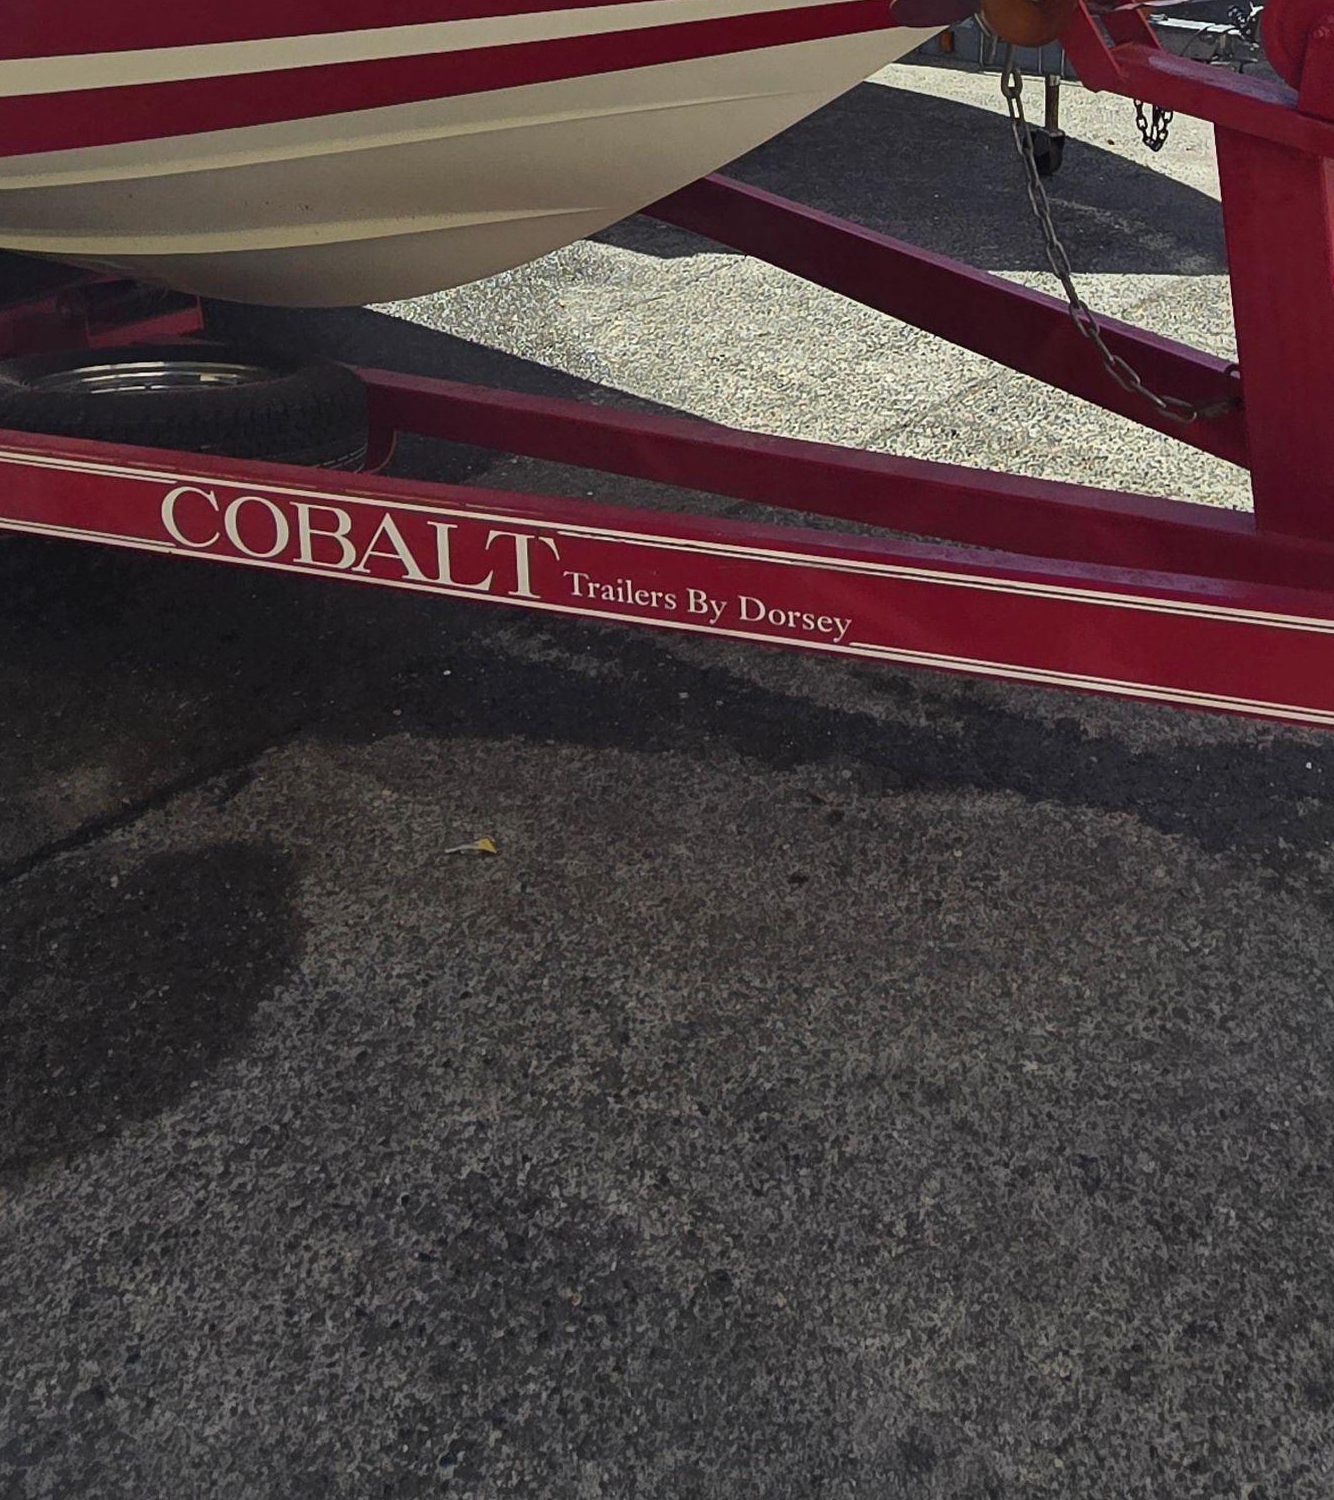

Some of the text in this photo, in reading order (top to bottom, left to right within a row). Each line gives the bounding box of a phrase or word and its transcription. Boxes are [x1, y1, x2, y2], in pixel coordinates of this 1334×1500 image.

[161, 486, 852, 643] COBALT Trailers By Dorsey
